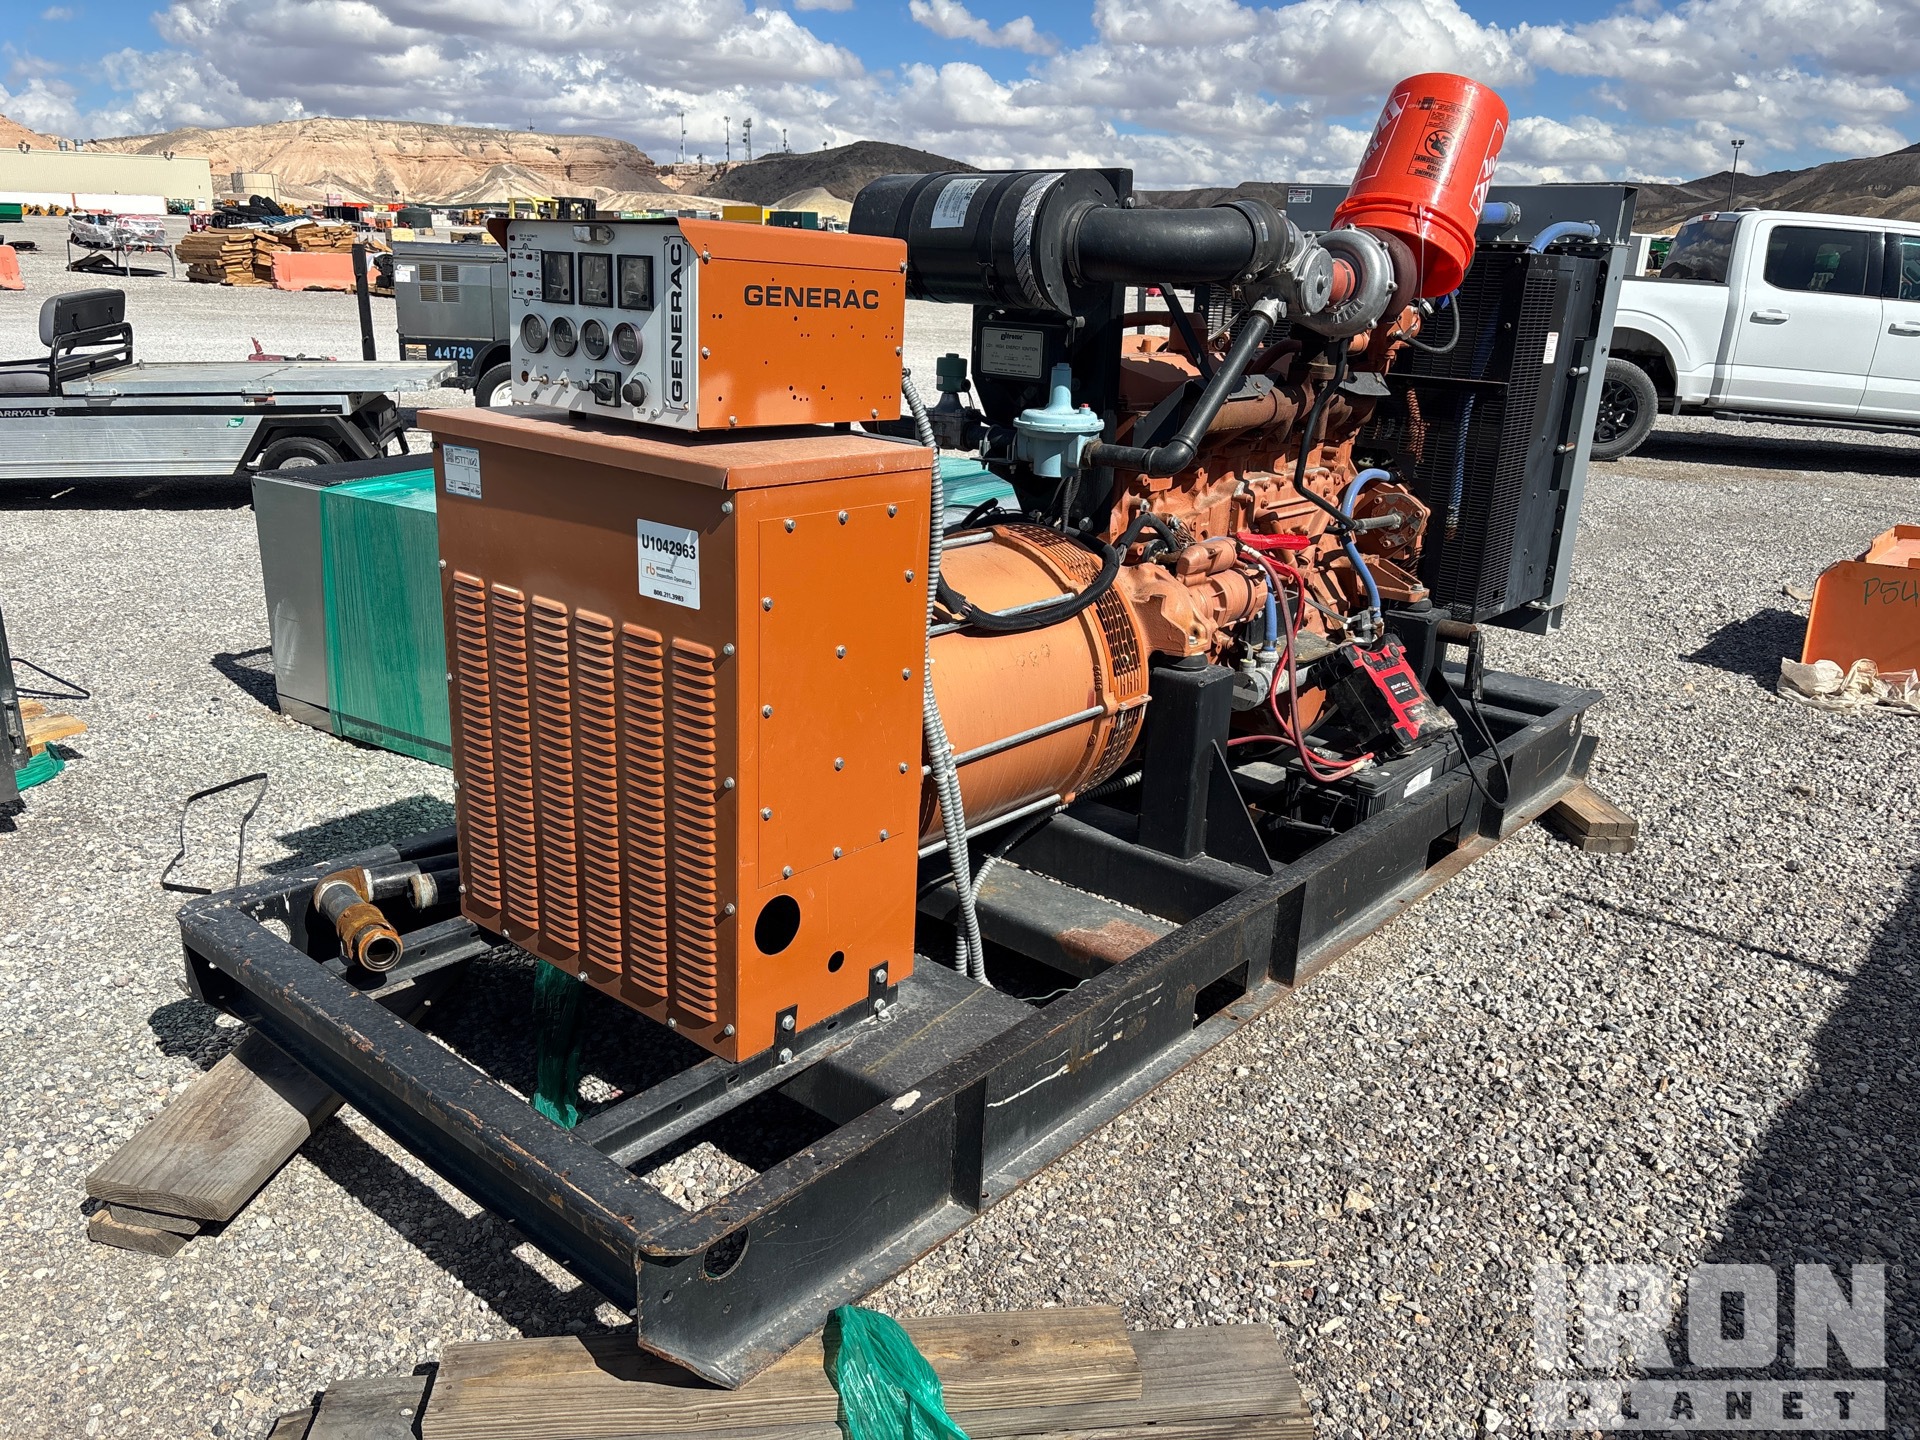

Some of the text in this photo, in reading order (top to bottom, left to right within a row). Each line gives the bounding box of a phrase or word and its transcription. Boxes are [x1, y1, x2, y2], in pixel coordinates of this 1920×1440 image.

[744, 285, 879, 309] GENERAC
[671, 244, 683, 402] GENERAC
[435, 346, 474, 360] 44729
[46, 408, 56, 417] 6
[642, 533, 696, 560] U1042963
[646, 562, 655, 576] rb
[1863, 577, 1919, 607] P54
